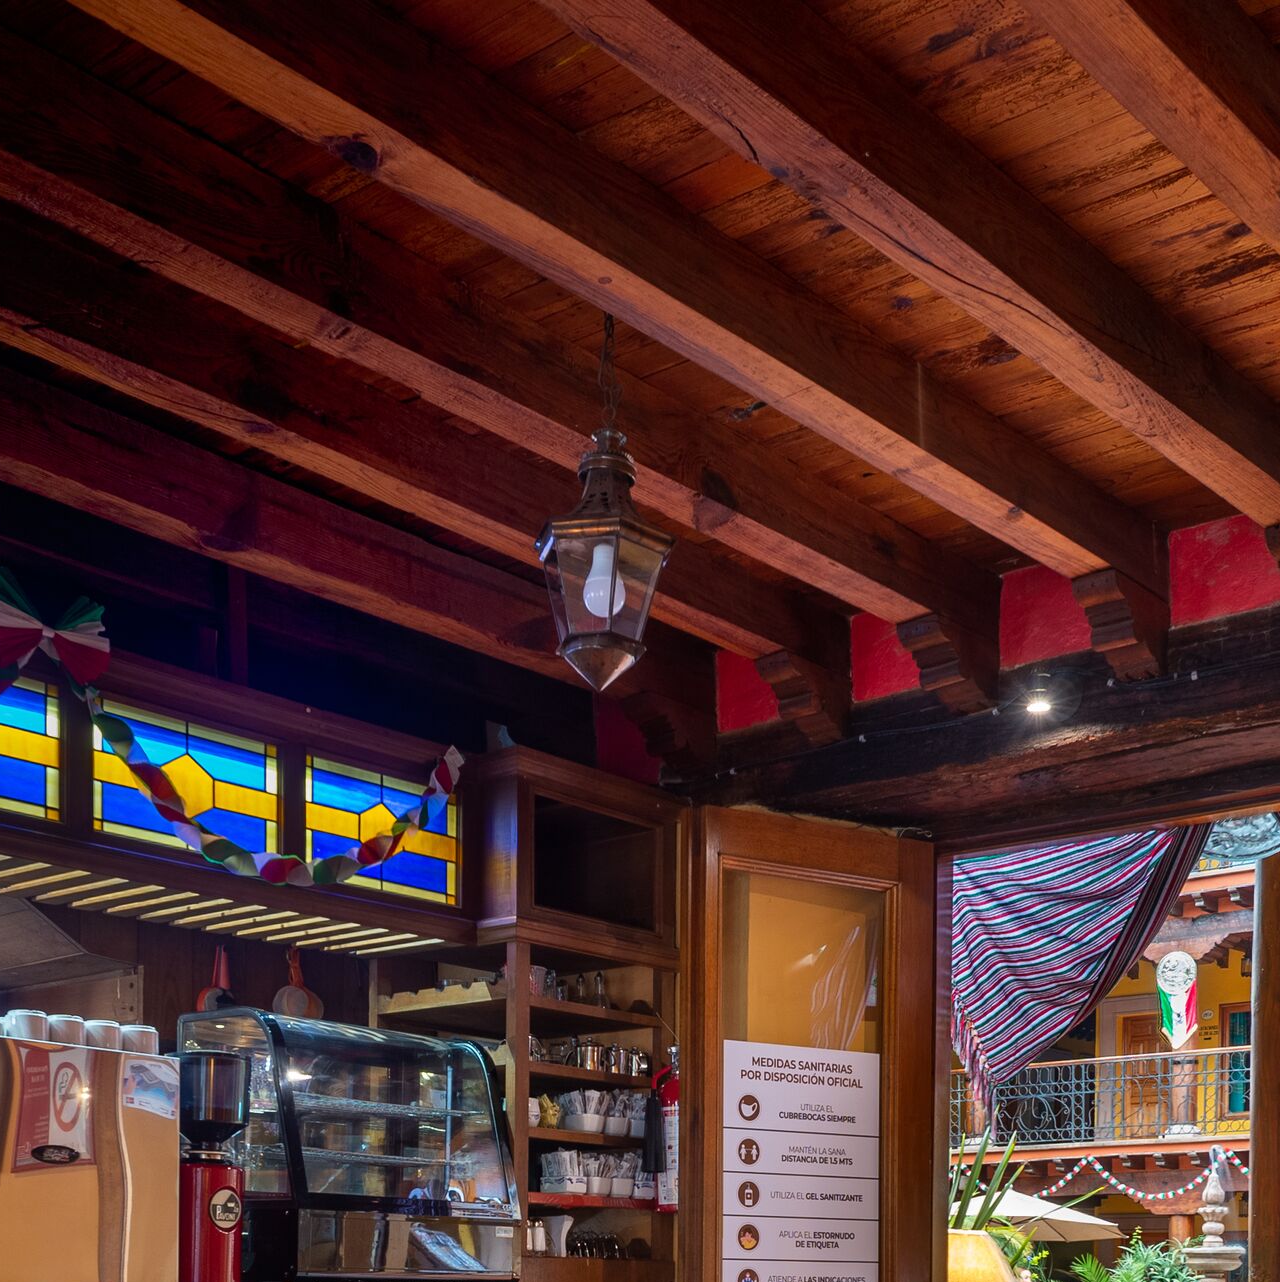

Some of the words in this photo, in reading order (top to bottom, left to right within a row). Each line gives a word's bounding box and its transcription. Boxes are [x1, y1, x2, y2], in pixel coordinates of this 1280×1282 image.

[752, 1057, 796, 1069] MEDIDAS
[798, 1061, 852, 1074] SANITARIAS
[740, 1070, 761, 1080] POR
[764, 1072, 824, 1086] DISPOSICIÓN
[827, 1077, 863, 1088] OFICIAL
[800, 1104, 825, 1112] UTILIZA
[826, 1105, 833, 1113] EL
[779, 1112, 825, 1121] CUBREBOCAS
[827, 1115, 856, 1123] SIEMPRE
[789, 1146, 817, 1154] MANTÉN
[828, 1148, 846, 1156] SANA
[782, 1155, 817, 1163] DISTANCIA
[770, 1191, 796, 1199] UTILIZA
[820, 1194, 863, 1202] SANITIZANTE
[804, 1231, 812, 1239] EL
[807, 1241, 839, 1249] ETIQUETA
